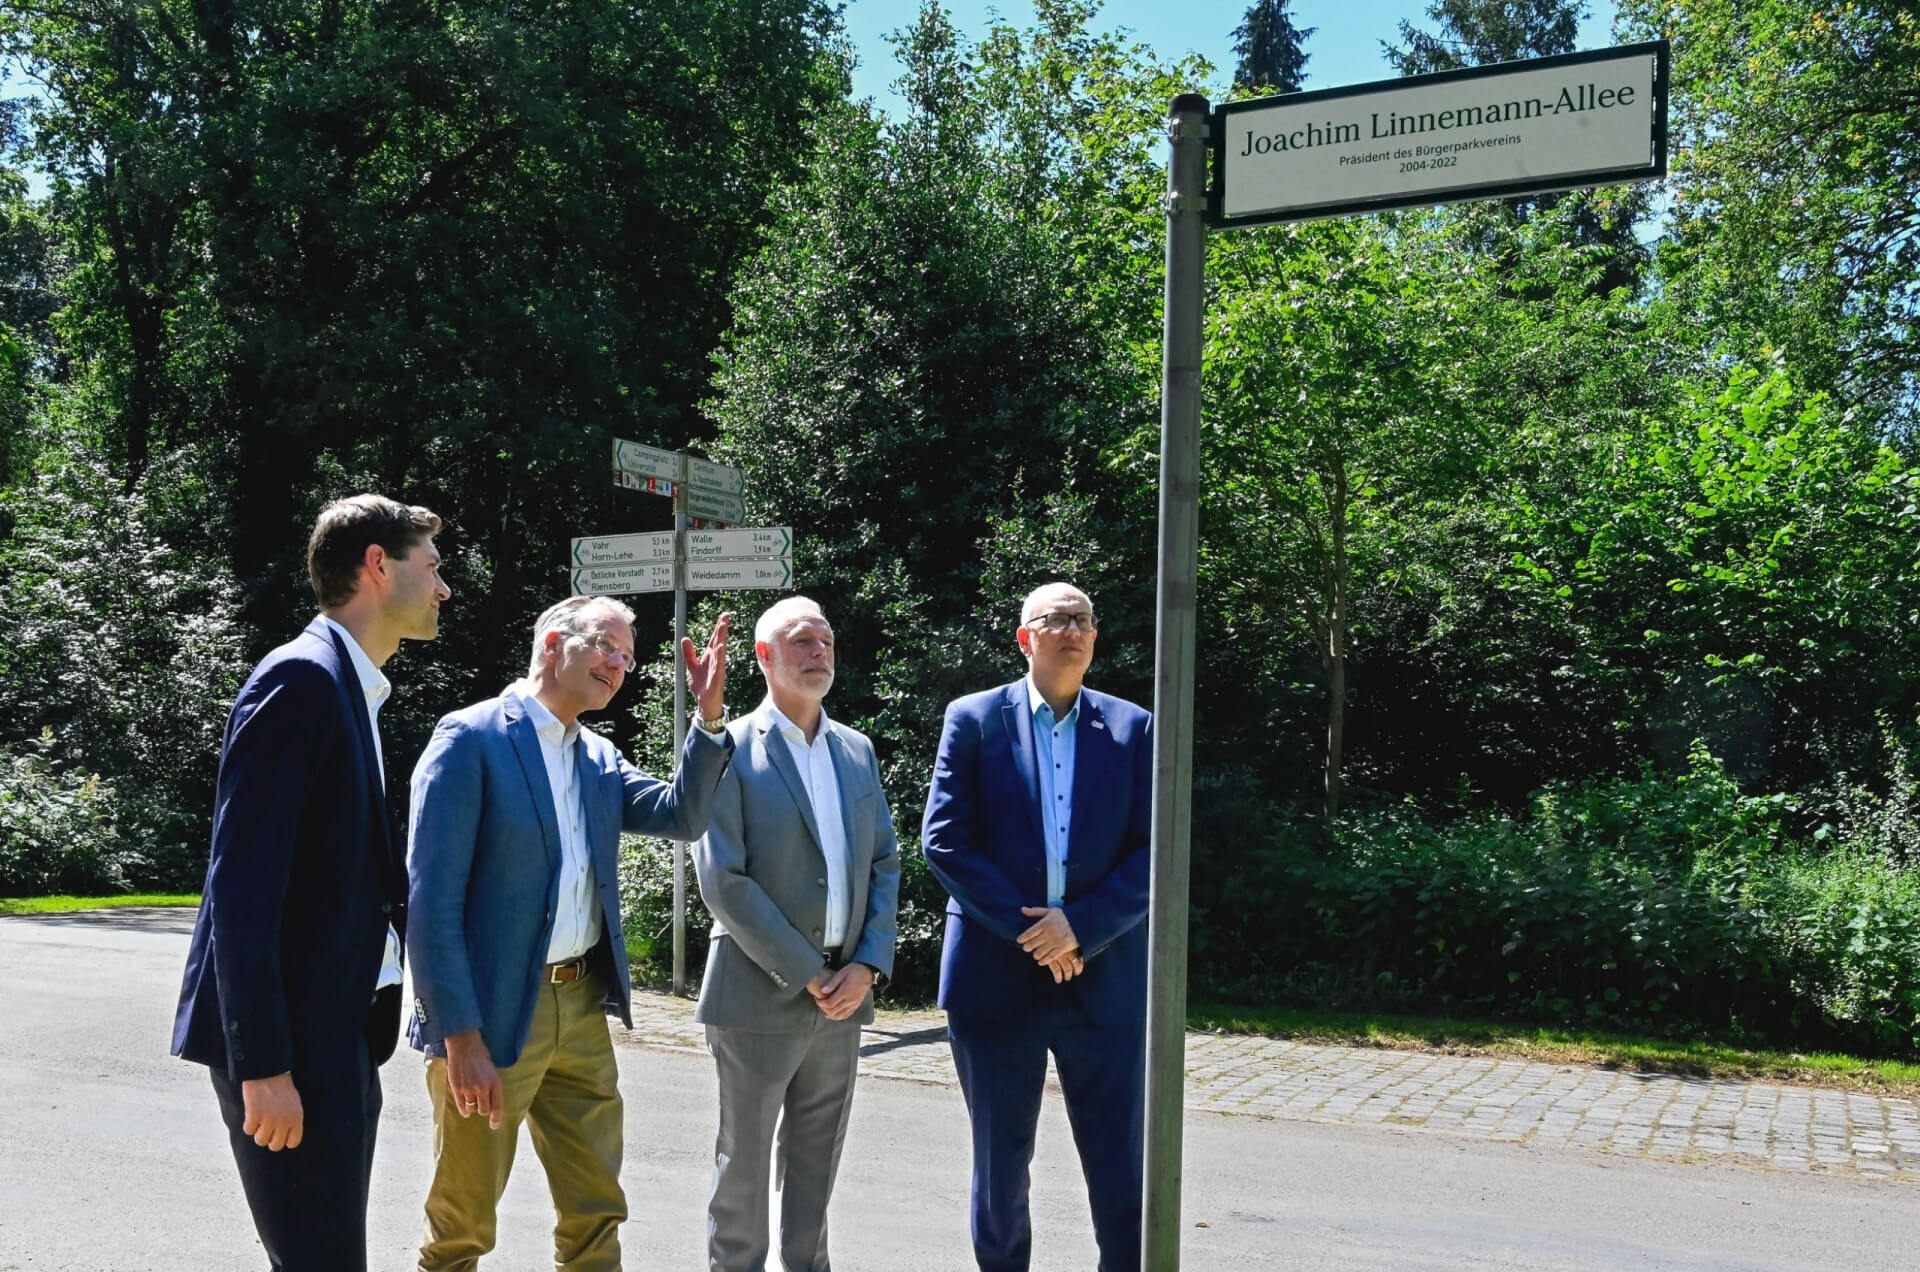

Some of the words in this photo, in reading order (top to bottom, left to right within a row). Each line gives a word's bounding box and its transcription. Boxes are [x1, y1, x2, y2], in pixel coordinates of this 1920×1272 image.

[1241, 121, 1361, 157] Joachim
[1371, 83, 1635, 139] Linnemann-Allee
[1339, 150, 1391, 166] Präsident
[1393, 146, 1413, 159] des
[1415, 133, 1522, 158] Bürgerparkvereins
[1399, 155, 1458, 174] 2004-2022
[691, 534, 713, 543] Walle
[591, 541, 610, 550] Vahr
[691, 545, 722, 555] Findorff
[591, 551, 634, 561] Horn-Lehe
[590, 569, 616, 580] Östliche
[617, 567, 644, 577] Vorstadt
[691, 570, 741, 580] Weidedamm
[591, 581, 631, 591] Riensberg
